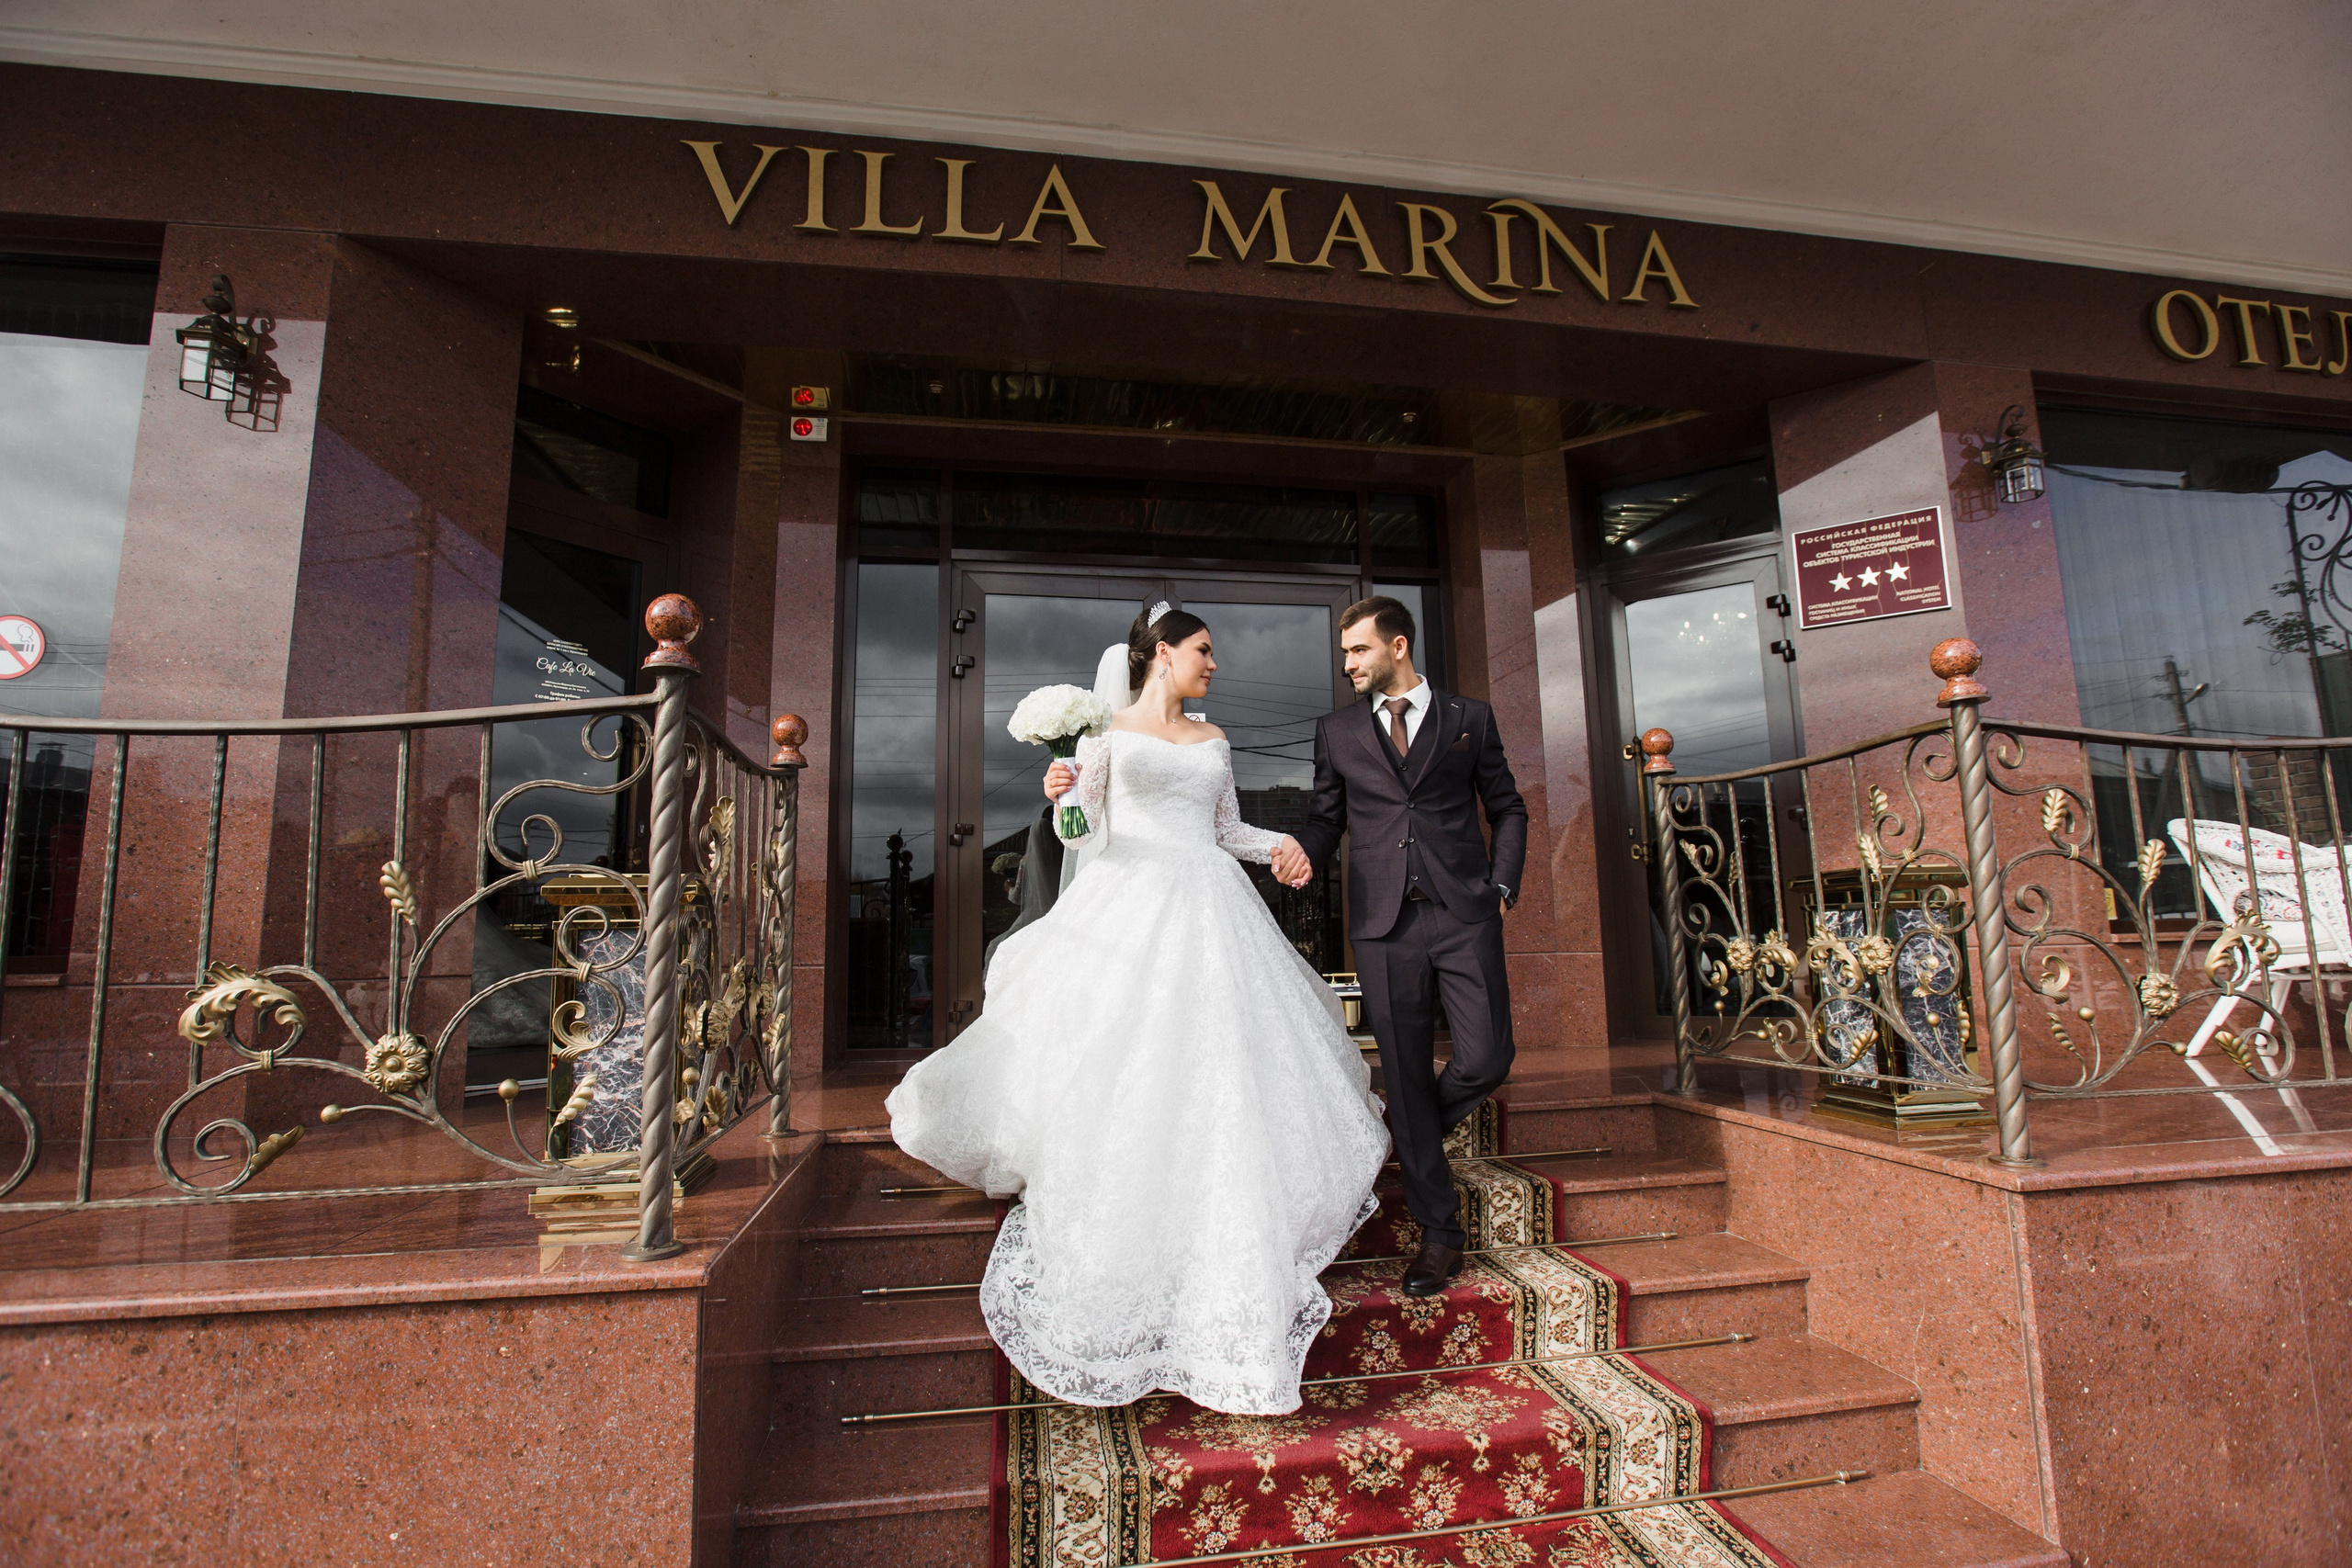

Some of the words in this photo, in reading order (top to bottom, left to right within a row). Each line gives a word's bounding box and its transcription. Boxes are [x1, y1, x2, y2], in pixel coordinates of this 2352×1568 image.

[679, 140, 1107, 250] VILLA
[1188, 180, 1700, 308] MARINA
[1800, 526, 1867, 545] РОССИЙСКАЯ
[1870, 514, 1932, 532] ФЕДЕРАЦИЯ
[1815, 547, 1849, 558] СИСТЕМА
[1849, 535, 1919, 553] КЛАССИФИКАЦИИ
[1831, 531, 1901, 549] ГОСУДАРСТВЕННАЯ
[1803, 556, 1840, 568] ОБЪЕКТОВ
[1840, 547, 1888, 561] ТУРИСТСКОЙ
[1888, 538, 1935, 553] ИНДУСТРИИ
[1895, 587, 1924, 596] NATIONAL
[1899, 591, 1941, 602] CLASSIFICATION
[1807, 602, 1831, 610] СИСТЕМА
[1831, 594, 1878, 606] КЛАССИФИКАЦИИ
[1808, 607, 1836, 615] ГОСТИНИЦ
[1830, 608, 1866, 618] РАЗМЕЩЕНИЯ
[536, 656, 559, 674] Cafe
[559, 660, 575, 676] La
[575, 662, 596, 677] Vie
